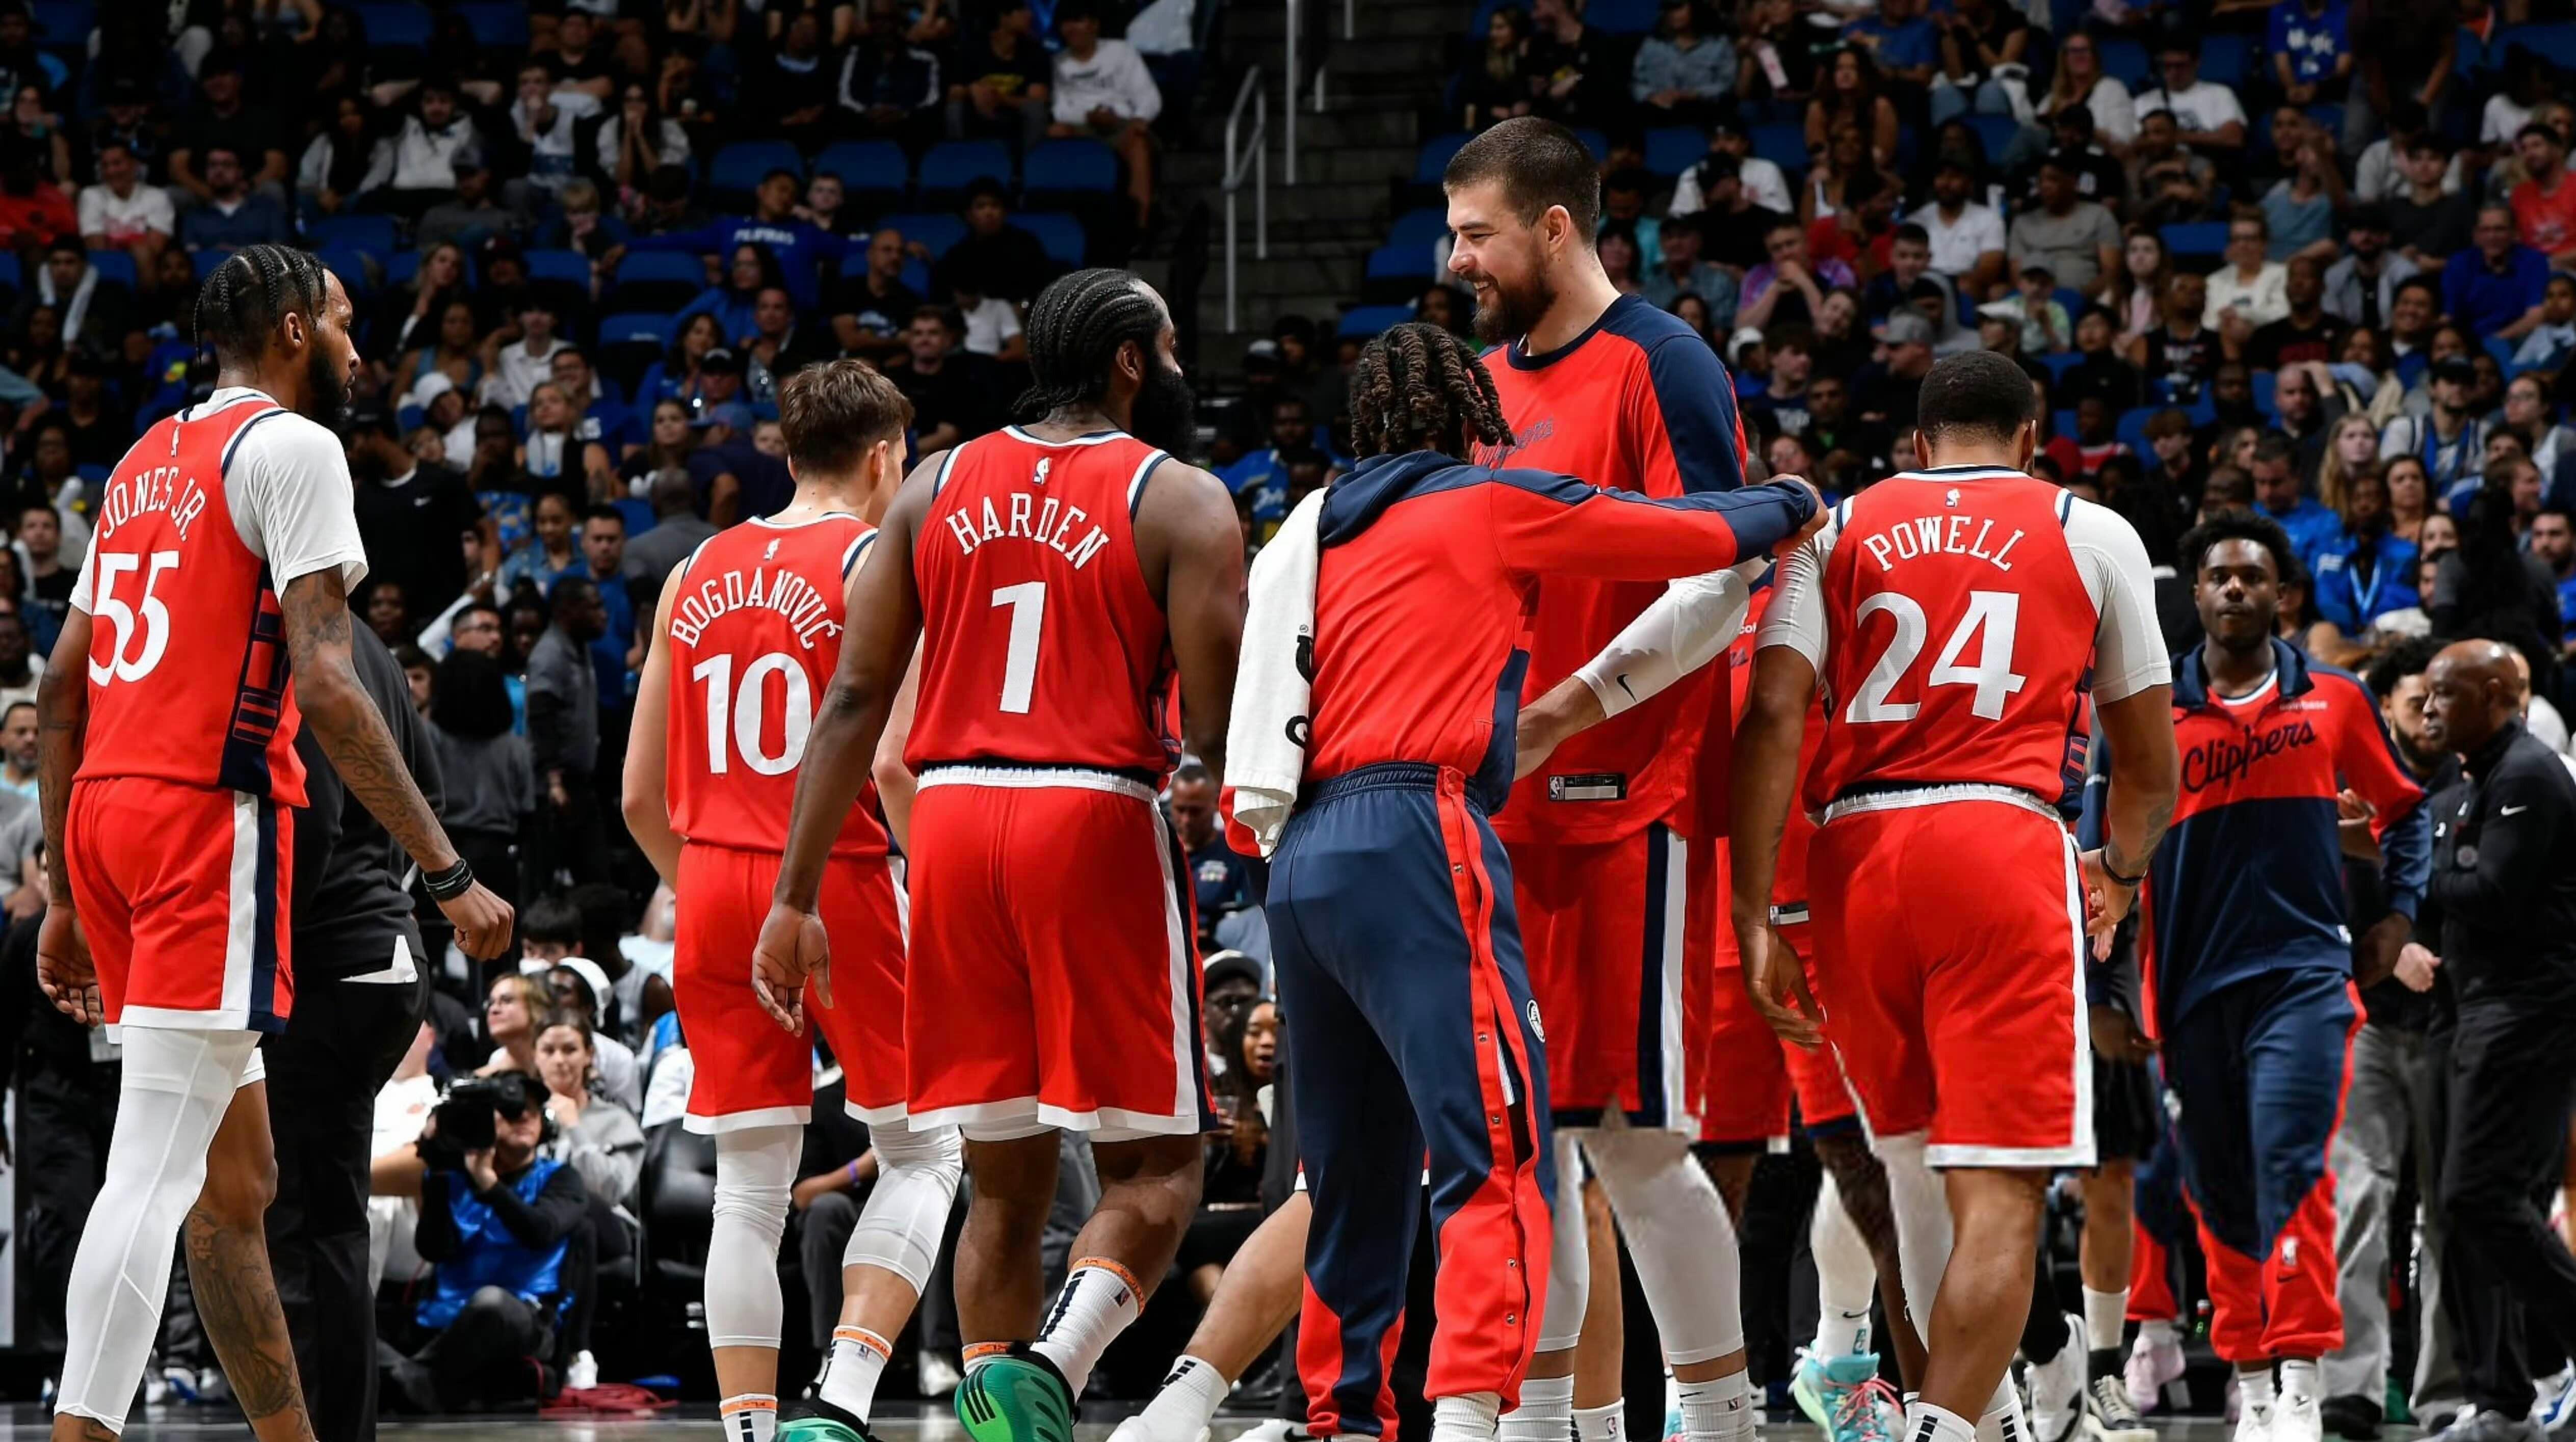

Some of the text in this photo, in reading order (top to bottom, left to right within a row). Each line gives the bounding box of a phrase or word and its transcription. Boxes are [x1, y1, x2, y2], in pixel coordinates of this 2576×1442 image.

[102, 466, 207, 543] JONES JR.
[945, 492, 1110, 571] HARDEN
[1863, 515, 2025, 572] POWELL
[89, 549, 180, 687] 55
[670, 567, 844, 650] BOGDANOVIĆ
[991, 581, 1046, 714] 1
[1845, 591, 2027, 724] 24
[692, 652, 812, 776] 10
[2183, 721, 2317, 793] Clippers
